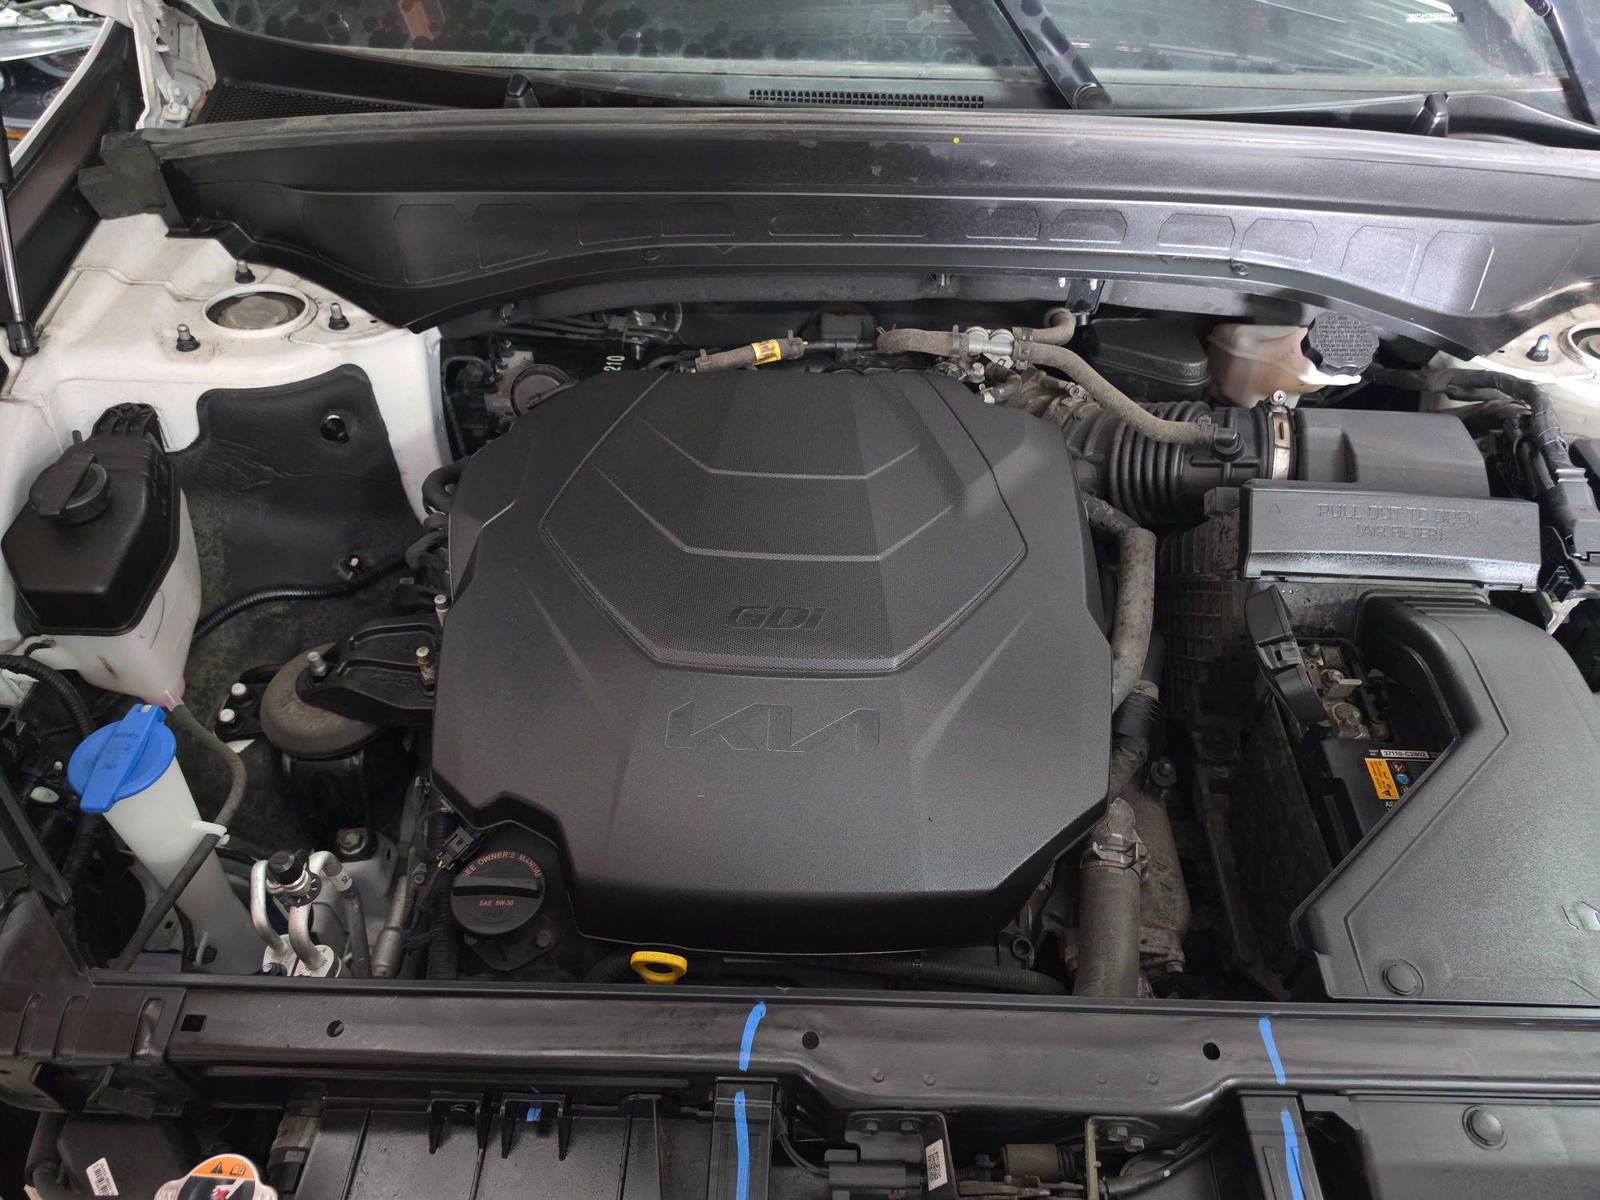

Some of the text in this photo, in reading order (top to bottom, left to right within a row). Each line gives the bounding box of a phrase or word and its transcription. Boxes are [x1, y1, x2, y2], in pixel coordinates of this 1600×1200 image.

[603, 355, 626, 372] 210
[1317, 503, 1480, 525] PULL OUT TO OPEN
[665, 701, 881, 752] KIA
[478, 851, 517, 865] OWNER'S
[518, 853, 543, 879] MANUAL
